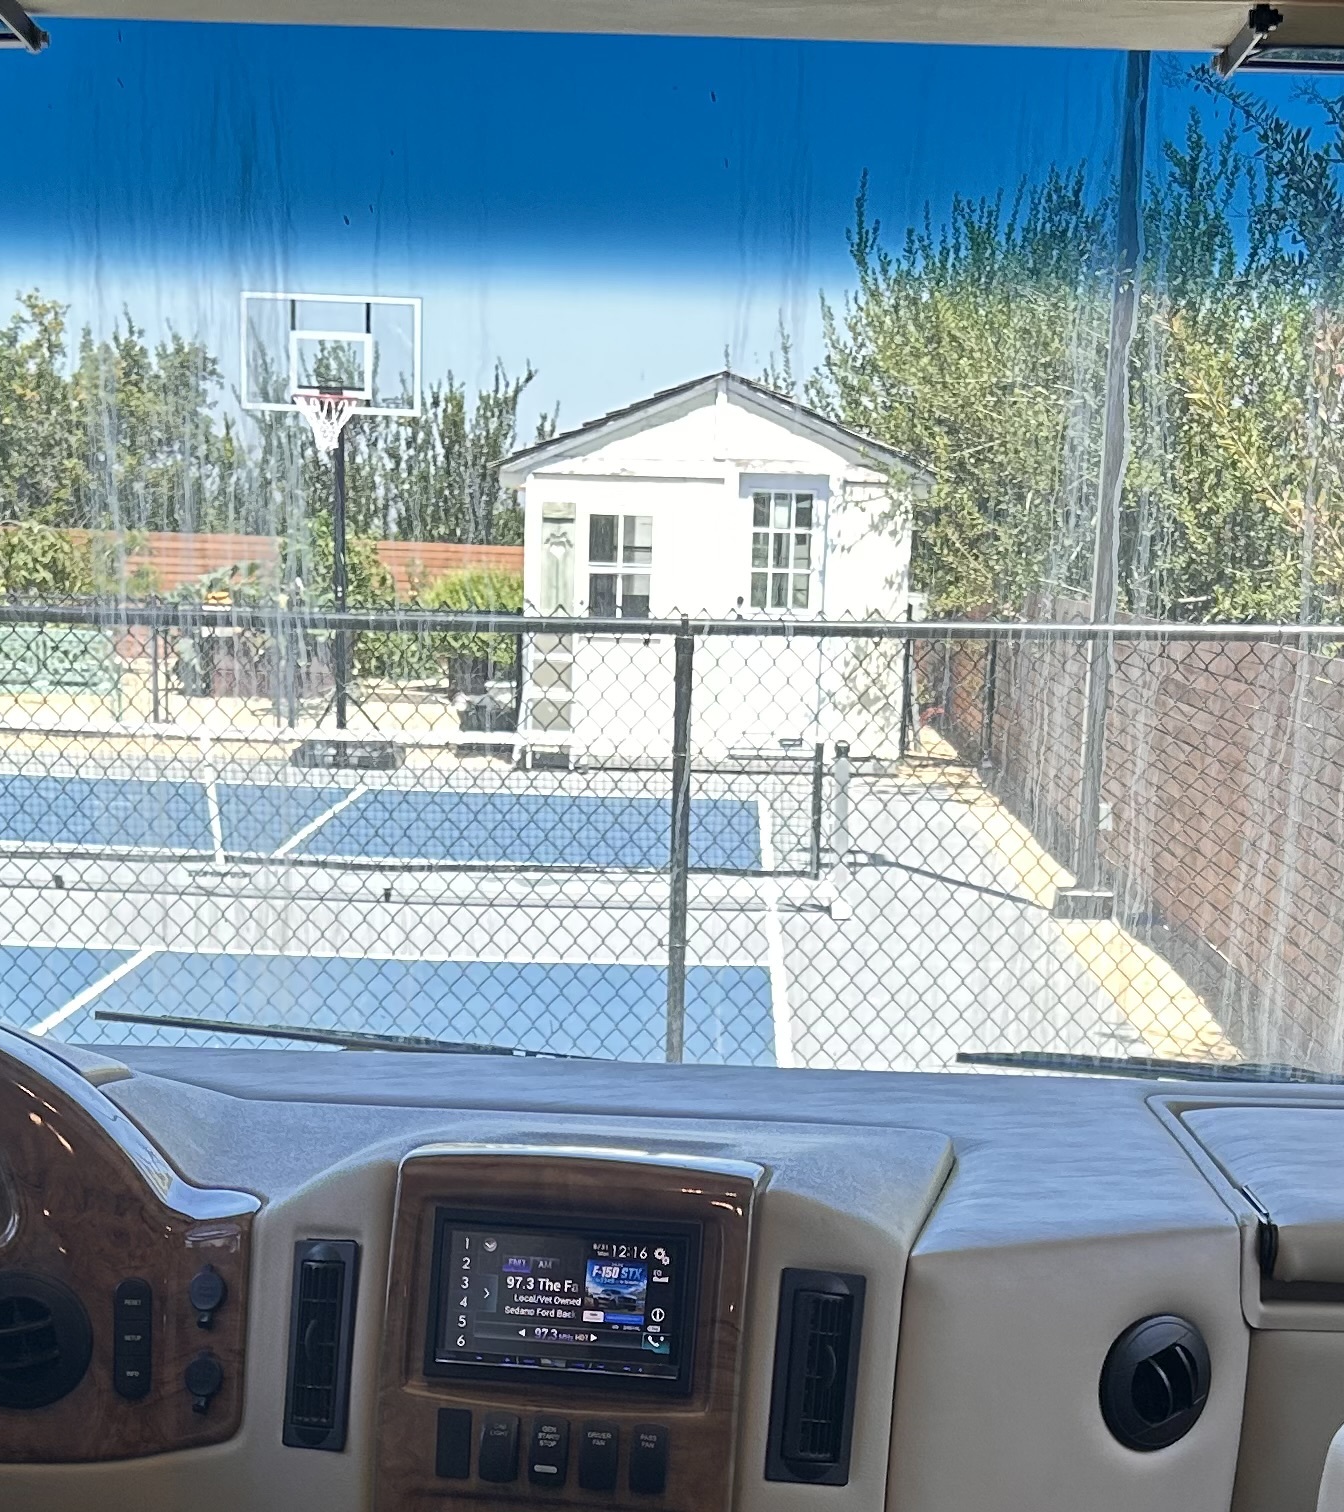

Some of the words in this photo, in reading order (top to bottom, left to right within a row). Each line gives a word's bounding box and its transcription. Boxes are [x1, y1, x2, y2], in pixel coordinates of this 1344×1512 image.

[464, 1237, 470, 1250] 1
[612, 1244, 648, 1260] 12:16
[461, 1256, 471, 1270] 2
[537, 1260, 552, 1269] AM
[592, 1265, 619, 1279] F-150
[620, 1267, 643, 1280] STX
[460, 1276, 469, 1289] 3
[506, 1276, 535, 1290] 97.3
[537, 1277, 561, 1292] The
[459, 1296, 468, 1308] 4
[553, 1296, 582, 1306] Owned
[536, 1308, 555, 1318] Ford
[457, 1315, 467, 1328] 5
[534, 1327, 558, 1340] 97.3
[456, 1334, 466, 1347] 6
